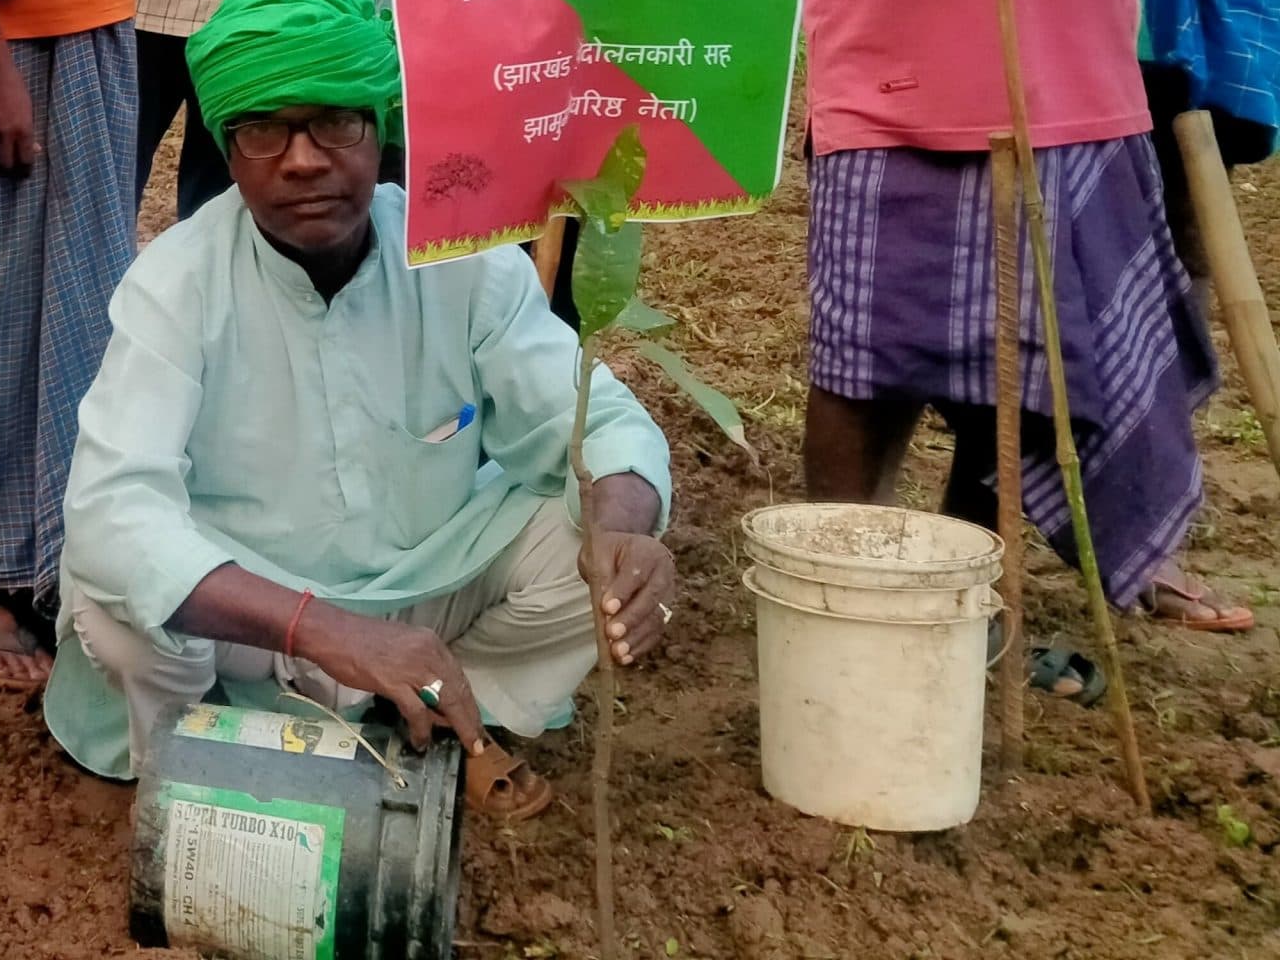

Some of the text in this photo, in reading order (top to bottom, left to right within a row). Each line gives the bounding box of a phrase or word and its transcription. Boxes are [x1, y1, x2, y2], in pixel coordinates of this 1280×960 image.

[493, 50, 573, 91] (झारखंड
[704, 43, 733, 67] सह
[570, 89, 626, 118] वरिष्ठ
[637, 92, 698, 123] नेता)
[220, 812, 267, 837] TURBO
[269, 820, 296, 842] X10
